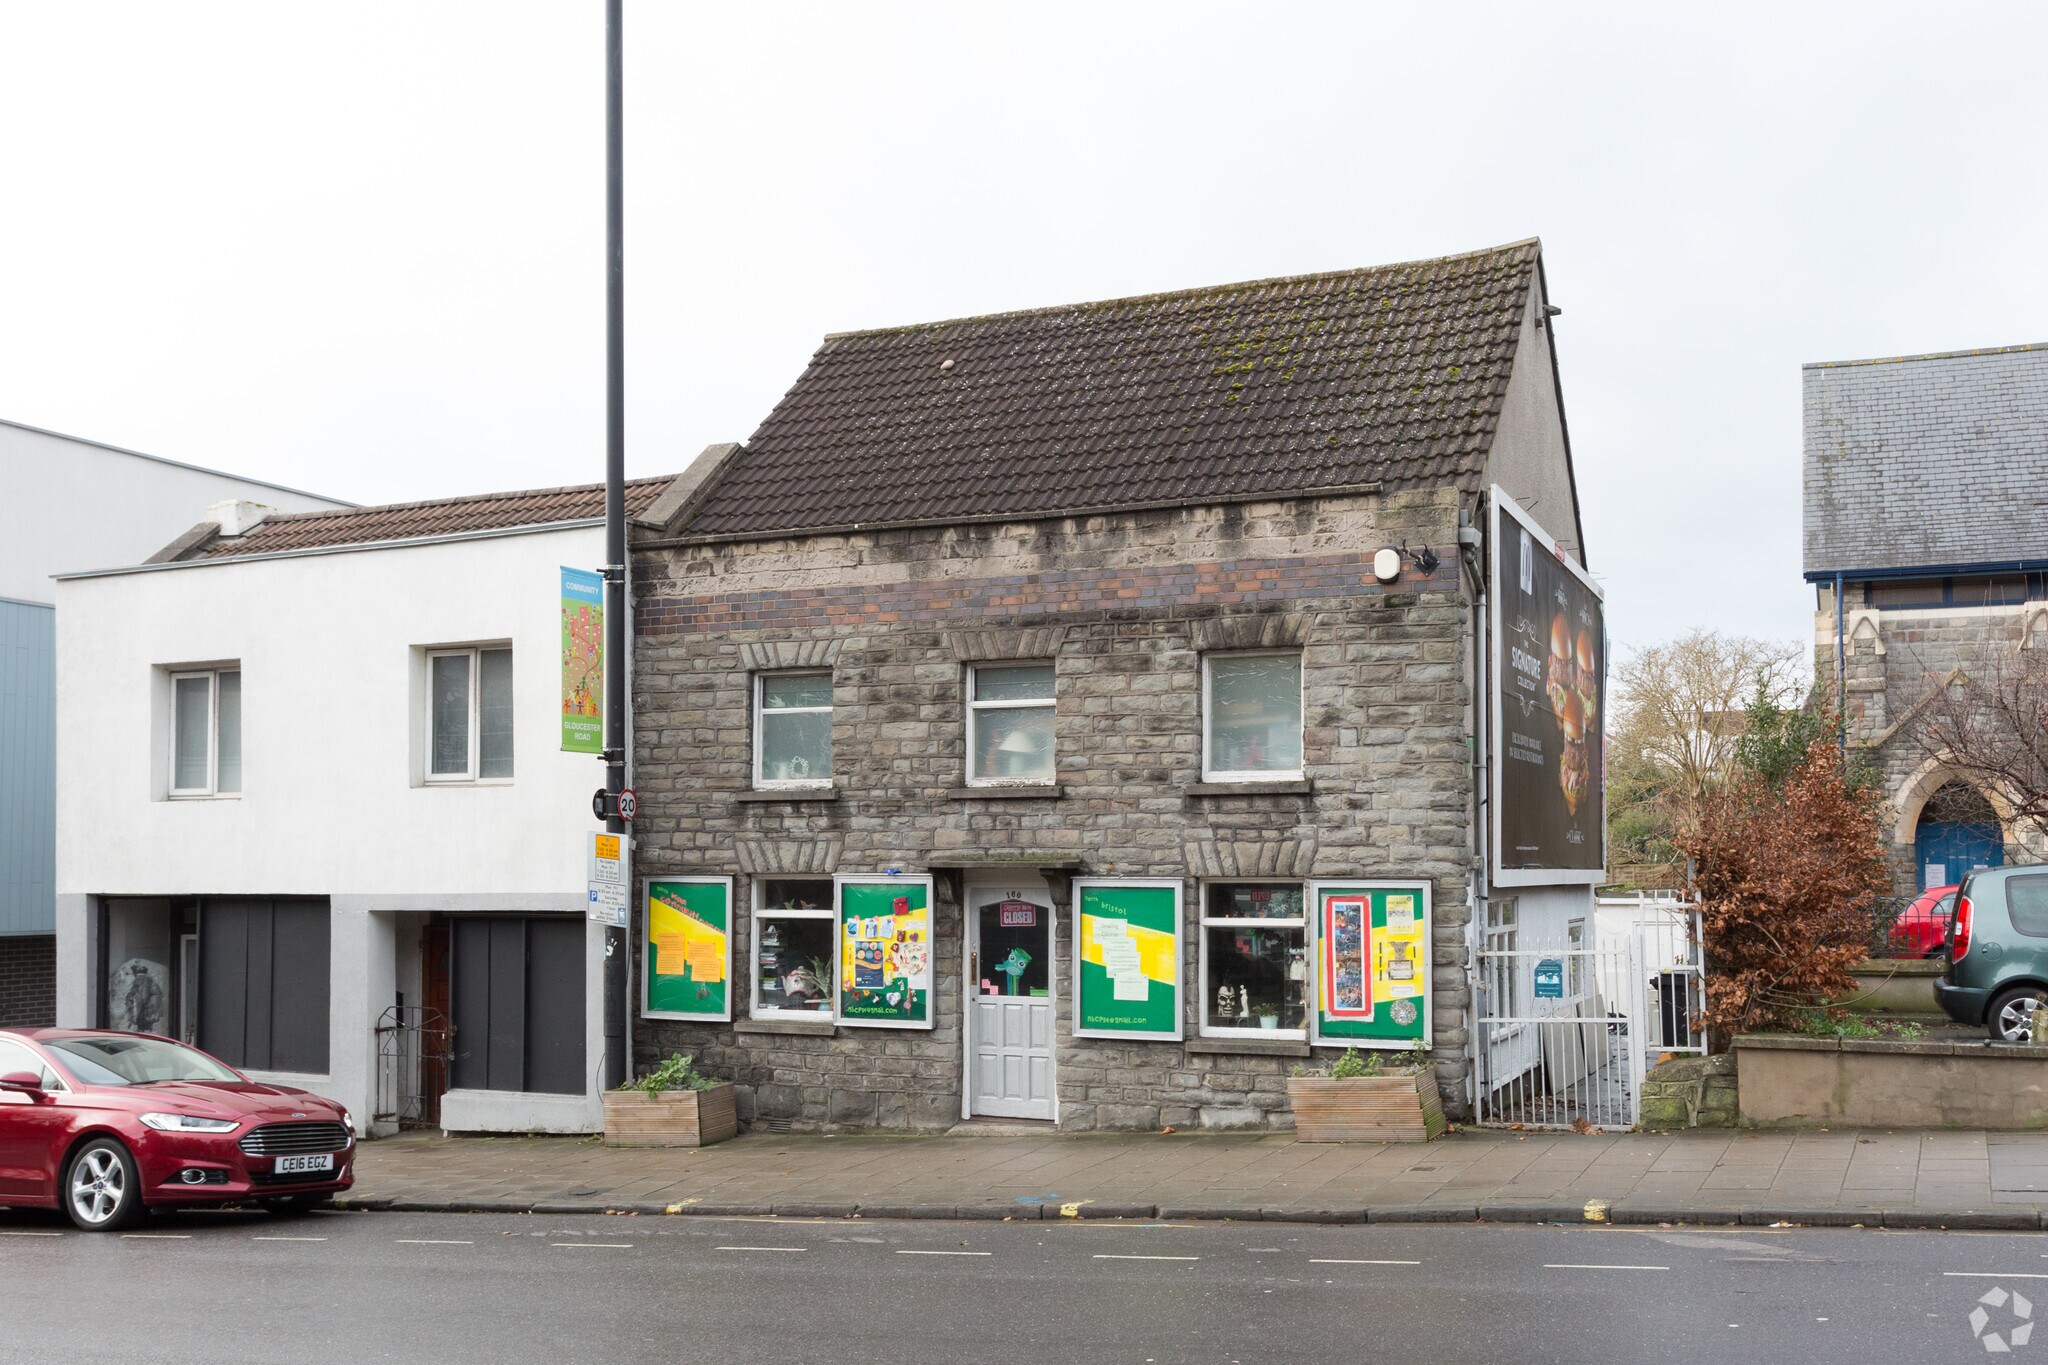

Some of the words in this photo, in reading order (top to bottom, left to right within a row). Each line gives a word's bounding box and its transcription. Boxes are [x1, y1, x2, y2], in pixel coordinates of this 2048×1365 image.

[566, 581, 599, 595] COMMUNITY
[1511, 646, 1541, 680] SIGNATURE
[564, 721, 601, 731] GLOUCESTER
[574, 732, 591, 741] ROAD
[621, 798, 635, 812] 20
[591, 891, 597, 901] P
[1101, 901, 1127, 915] bristol
[1003, 911, 1033, 924] CLOSED
[282, 1157, 305, 1171] CE16
[307, 1156, 328, 1169] EGZ
